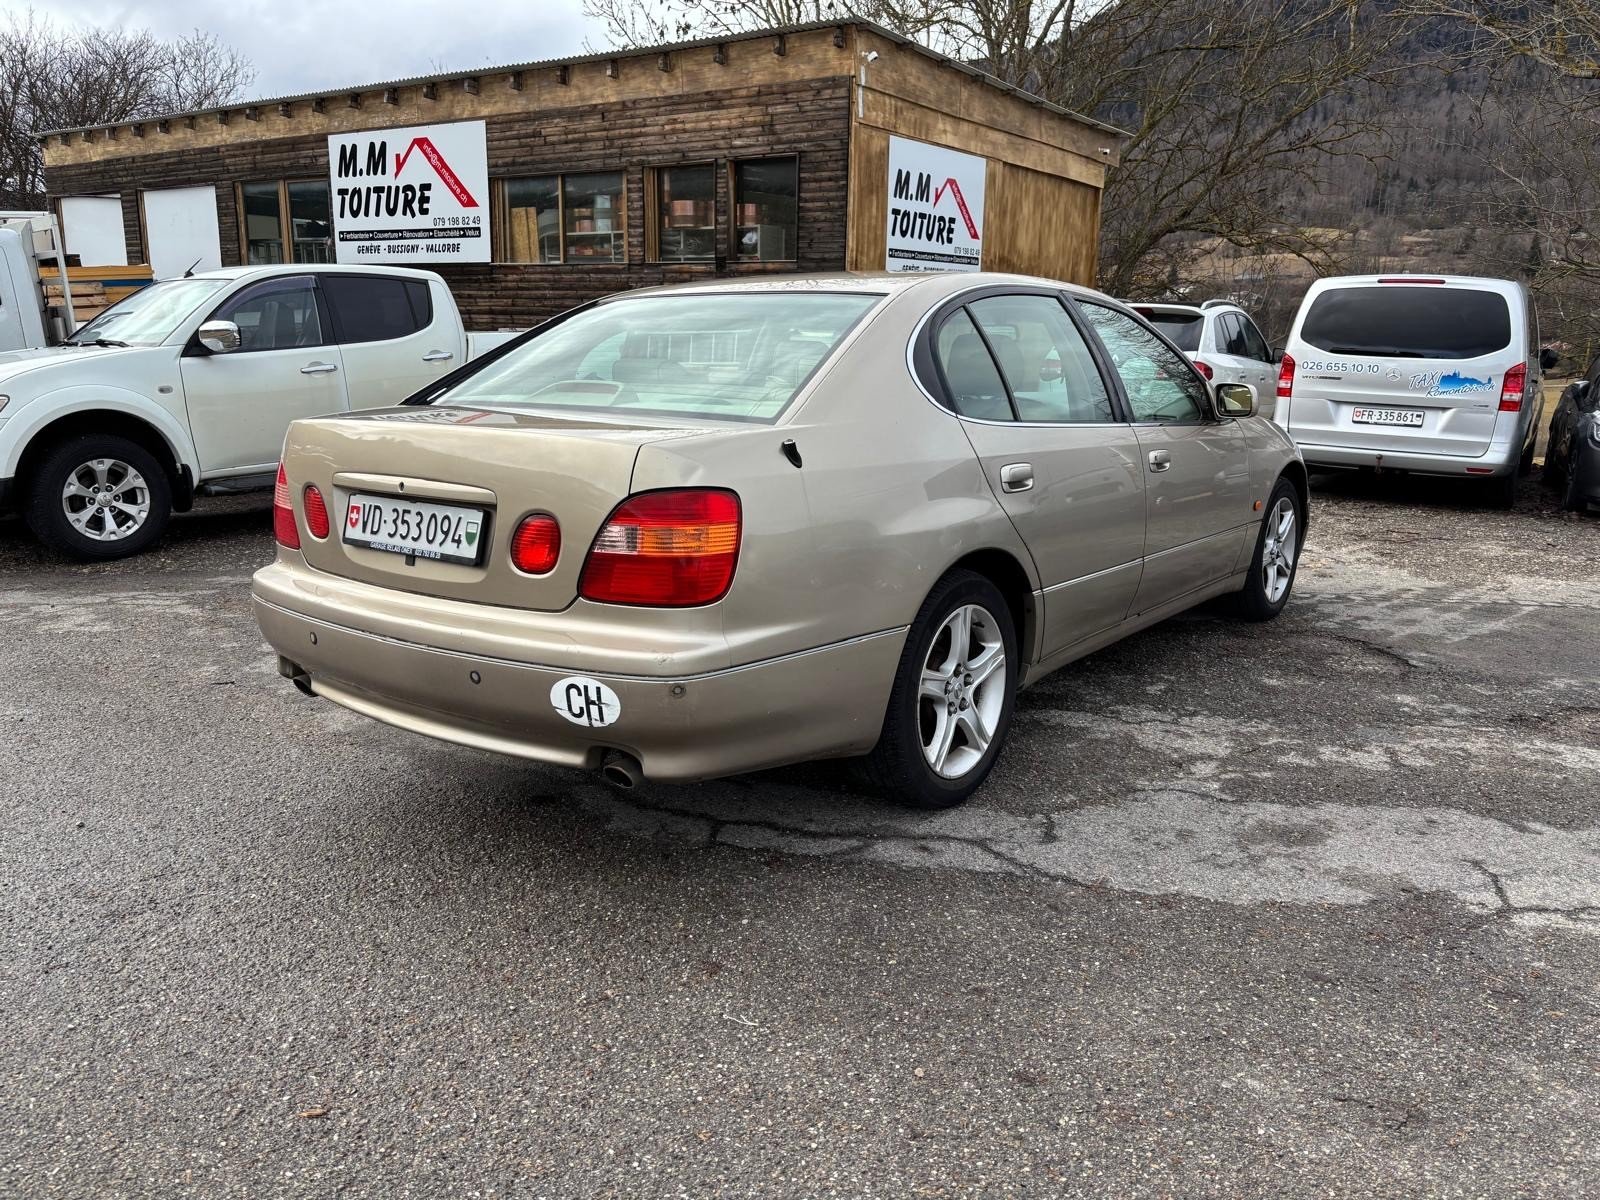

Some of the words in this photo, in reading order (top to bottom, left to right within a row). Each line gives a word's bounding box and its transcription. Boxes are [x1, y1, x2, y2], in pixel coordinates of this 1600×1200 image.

[338, 141, 387, 178] M.M
[893, 168, 931, 203] M.M
[337, 183, 432, 219] TOITURE
[433, 217, 446, 227] 079
[448, 217, 460, 226] 198
[461, 216, 471, 226] 82
[472, 216, 481, 225] 49
[891, 207, 956, 245] TOITURE
[343, 232, 370, 240] Ferblanterie
[373, 231, 399, 239] Couverture
[402, 230, 430, 238] Rénovation
[357, 243, 381, 254] GENÈVE
[387, 244, 419, 254] BUSSIGNY
[425, 243, 461, 253] VALLORBE
[1302, 361, 1323, 370] 026
[1326, 362, 1348, 372] 655
[1351, 364, 1364, 373] 10
[1367, 364, 1380, 374] 10
[1409, 370, 1444, 389] TAXI
[1426, 384, 1496, 398] Romontois.ch
[565, 683, 604, 724] CH
